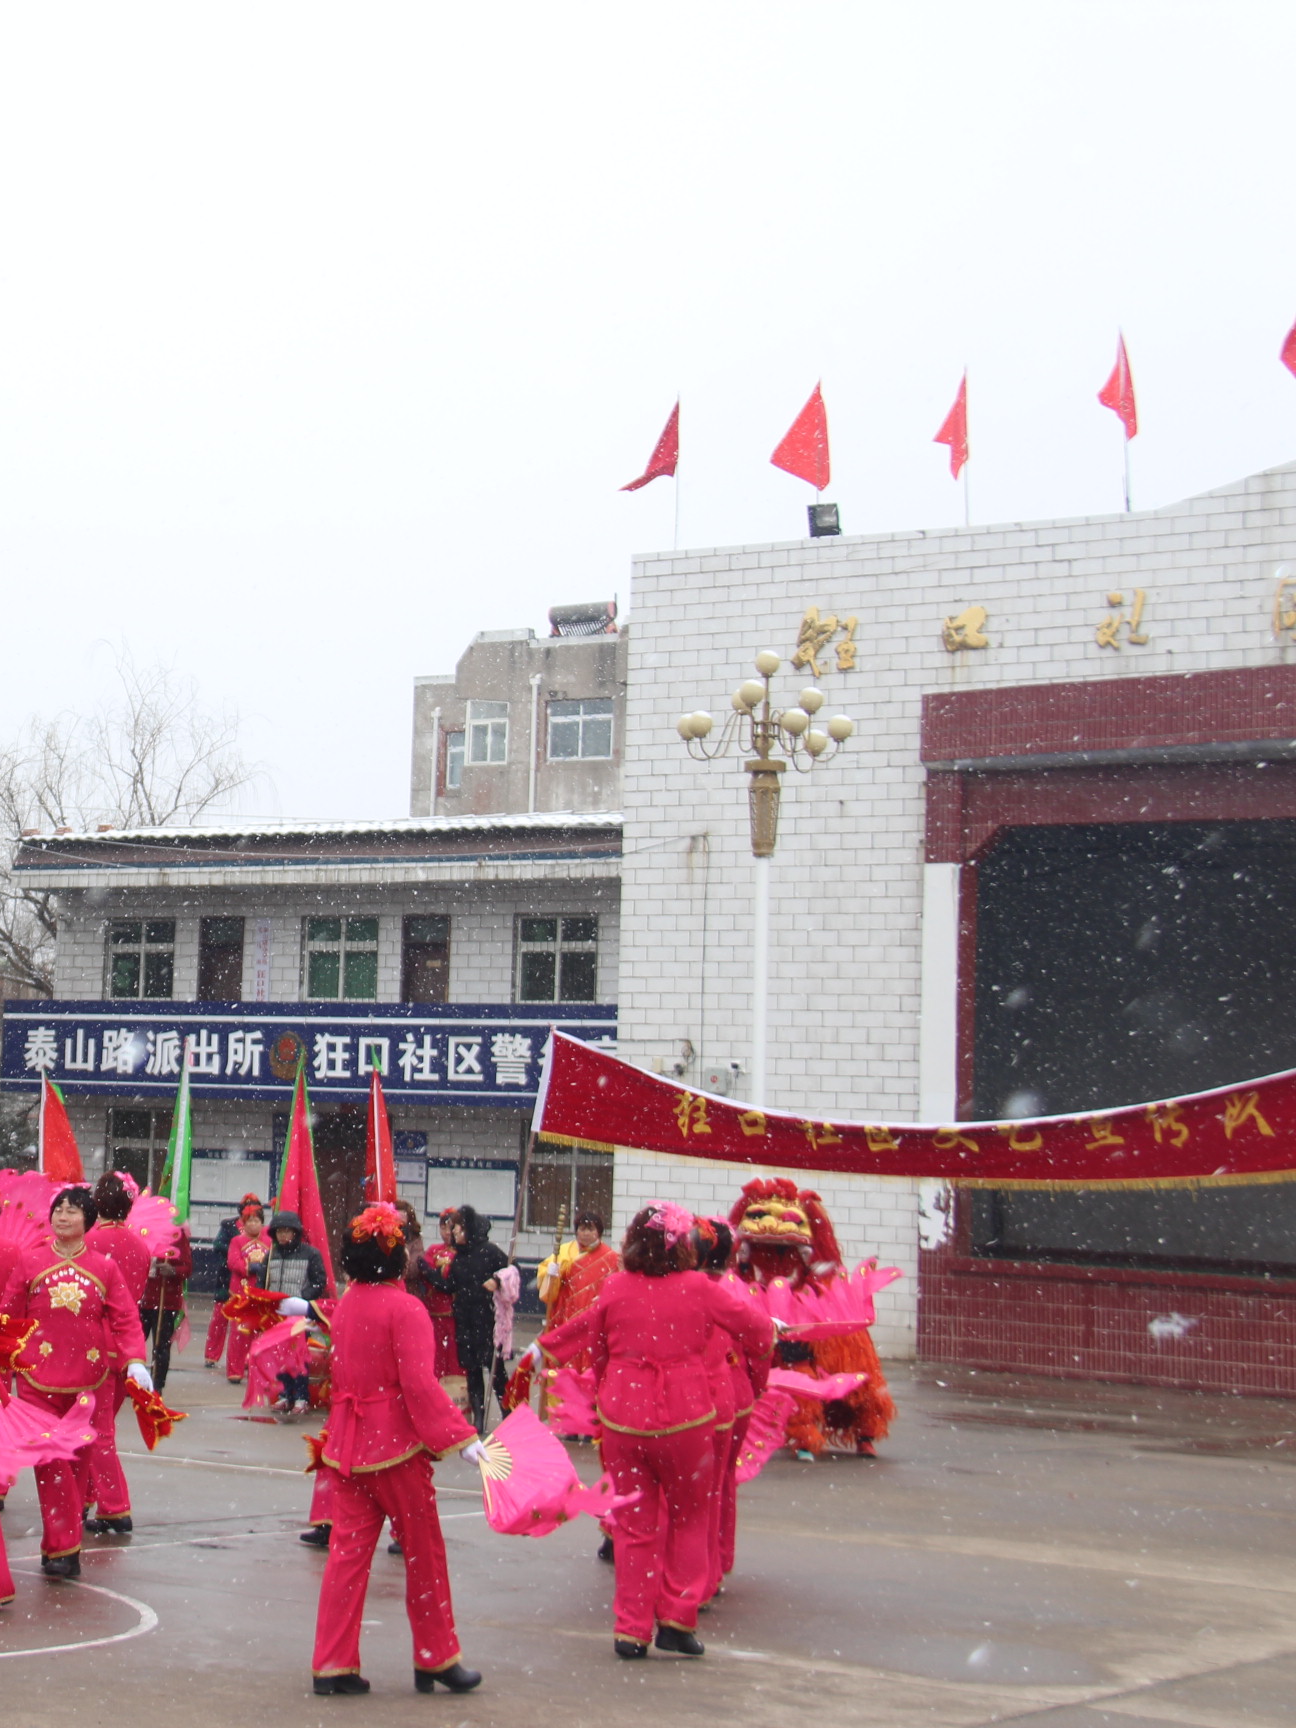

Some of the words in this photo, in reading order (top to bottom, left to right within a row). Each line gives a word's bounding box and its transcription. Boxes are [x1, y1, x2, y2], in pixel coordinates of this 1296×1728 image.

[23, 1026, 264, 1077] 泰山路派出所
[312, 1032, 616, 1086] 狂口社区警
